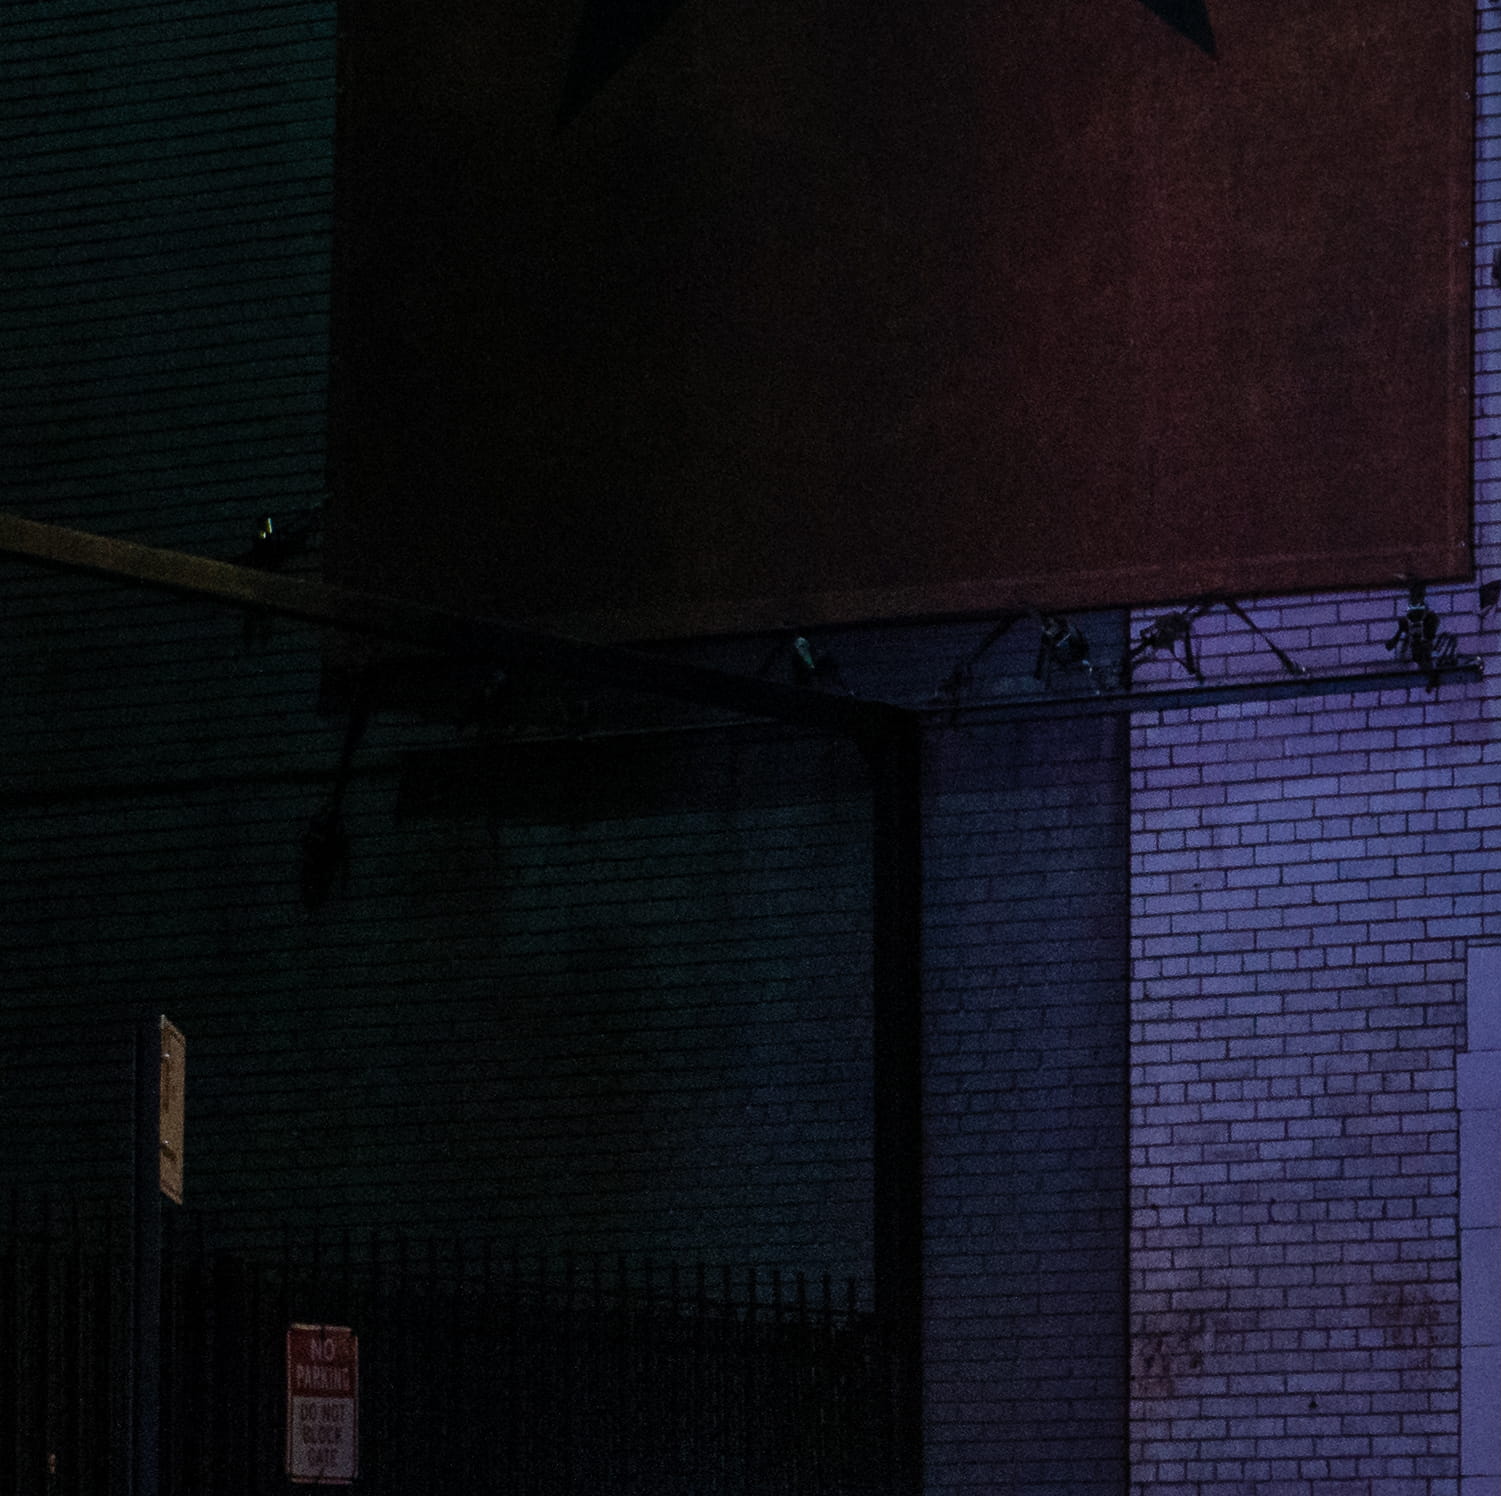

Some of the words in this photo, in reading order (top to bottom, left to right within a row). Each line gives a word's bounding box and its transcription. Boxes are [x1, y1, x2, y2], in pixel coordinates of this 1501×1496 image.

[311, 1337, 336, 1361] NO
[296, 1363, 351, 1391] PARKING
[300, 1403, 317, 1421] DO
[322, 1403, 346, 1421] NOT
[302, 1424, 342, 1444] BLOCK
[307, 1447, 339, 1467] GATE
